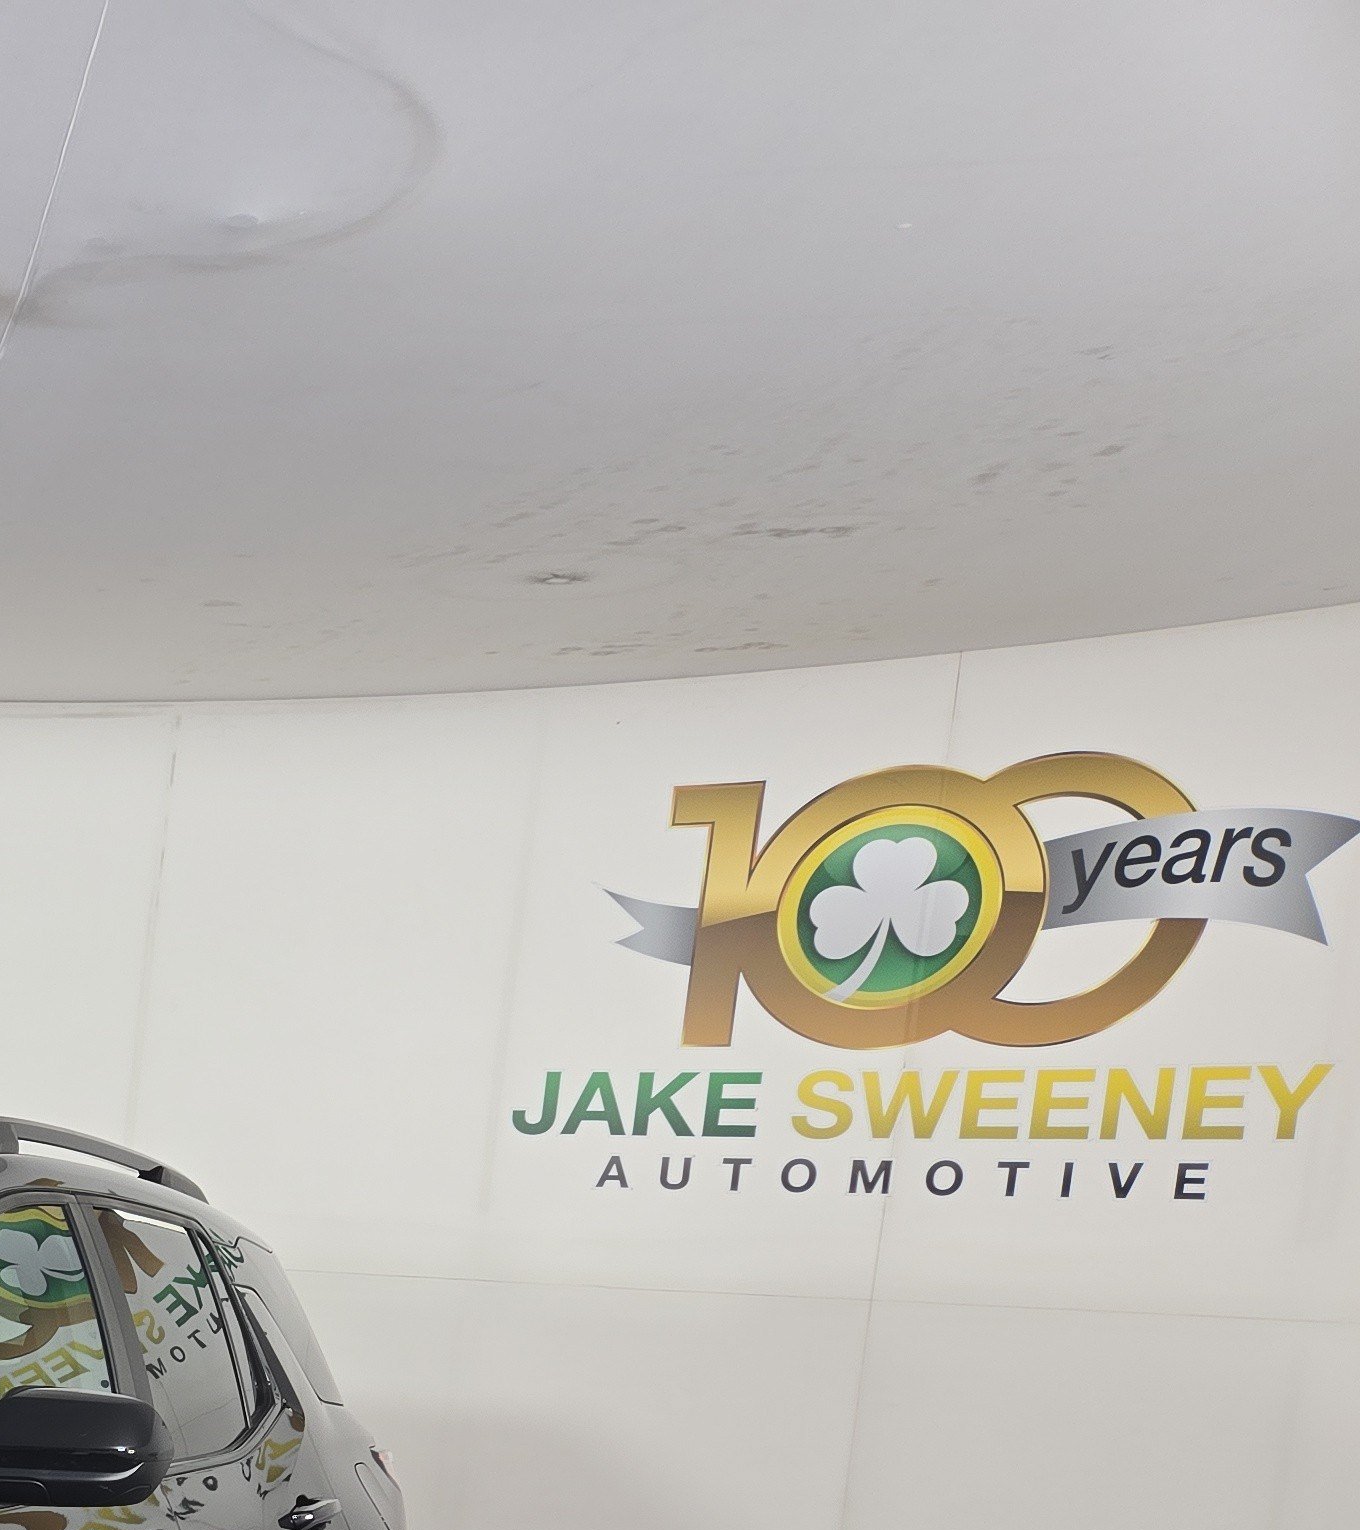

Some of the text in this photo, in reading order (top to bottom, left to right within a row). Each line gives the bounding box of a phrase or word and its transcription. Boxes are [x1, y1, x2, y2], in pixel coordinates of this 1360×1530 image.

[668, 750, 1293, 1050] 100 years
[511, 1063, 1335, 1141] JAKE SWEENEY
[595, 1155, 1210, 1201] AUTOMOTIVE
